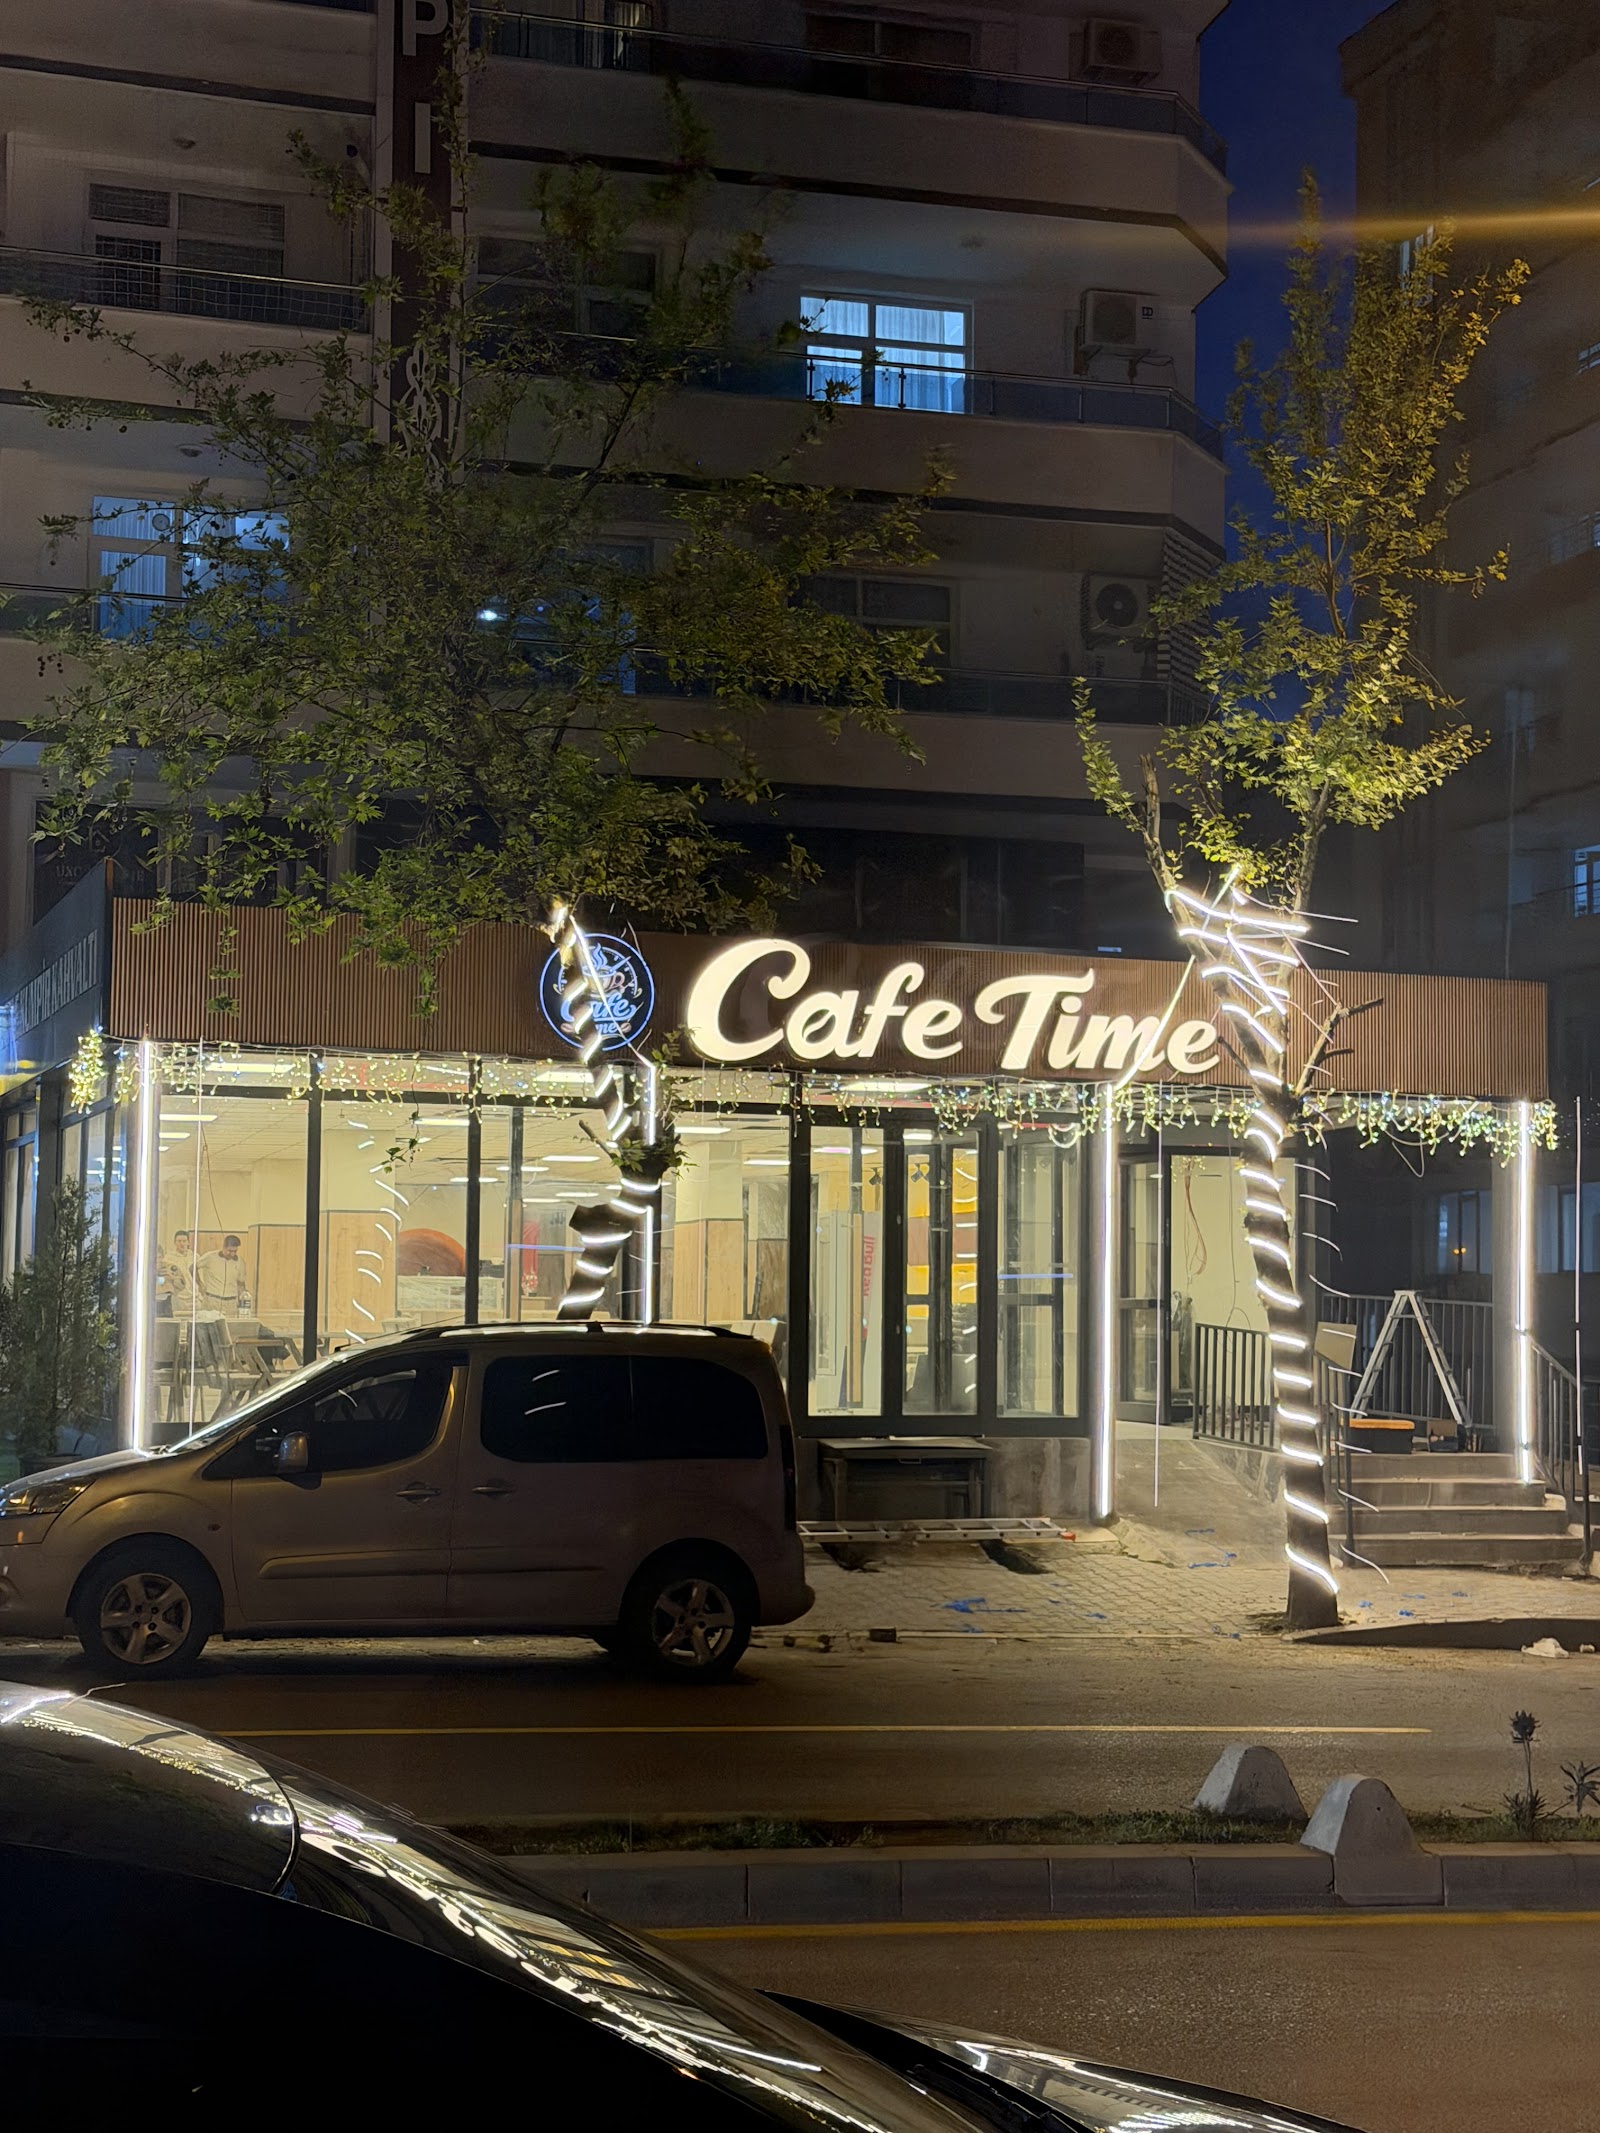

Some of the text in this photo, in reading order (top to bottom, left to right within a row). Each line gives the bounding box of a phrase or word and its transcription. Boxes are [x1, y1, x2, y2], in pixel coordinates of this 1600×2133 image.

[51, 929, 97, 1015] KAHVALTI
[687, 938, 1220, 1074] Cafe Time
